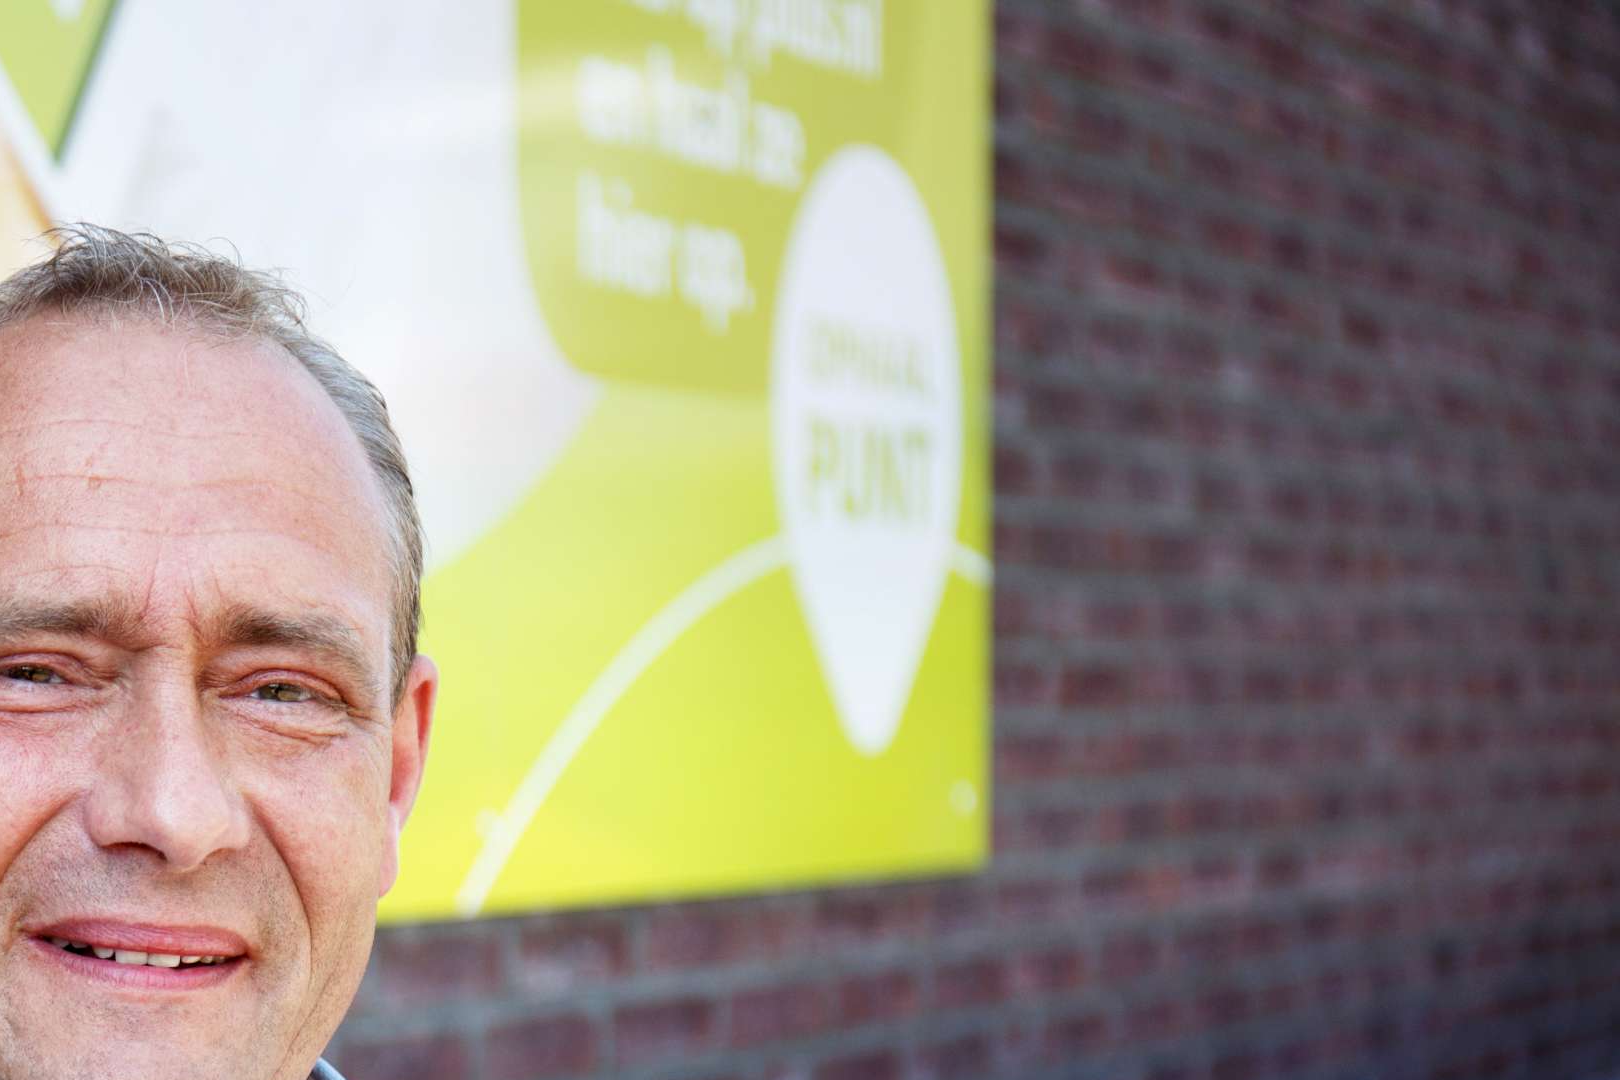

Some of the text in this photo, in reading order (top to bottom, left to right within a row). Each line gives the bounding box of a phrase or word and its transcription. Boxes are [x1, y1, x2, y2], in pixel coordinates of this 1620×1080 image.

[576, 170, 755, 334] hier op.
[806, 412, 932, 526] PUNT
